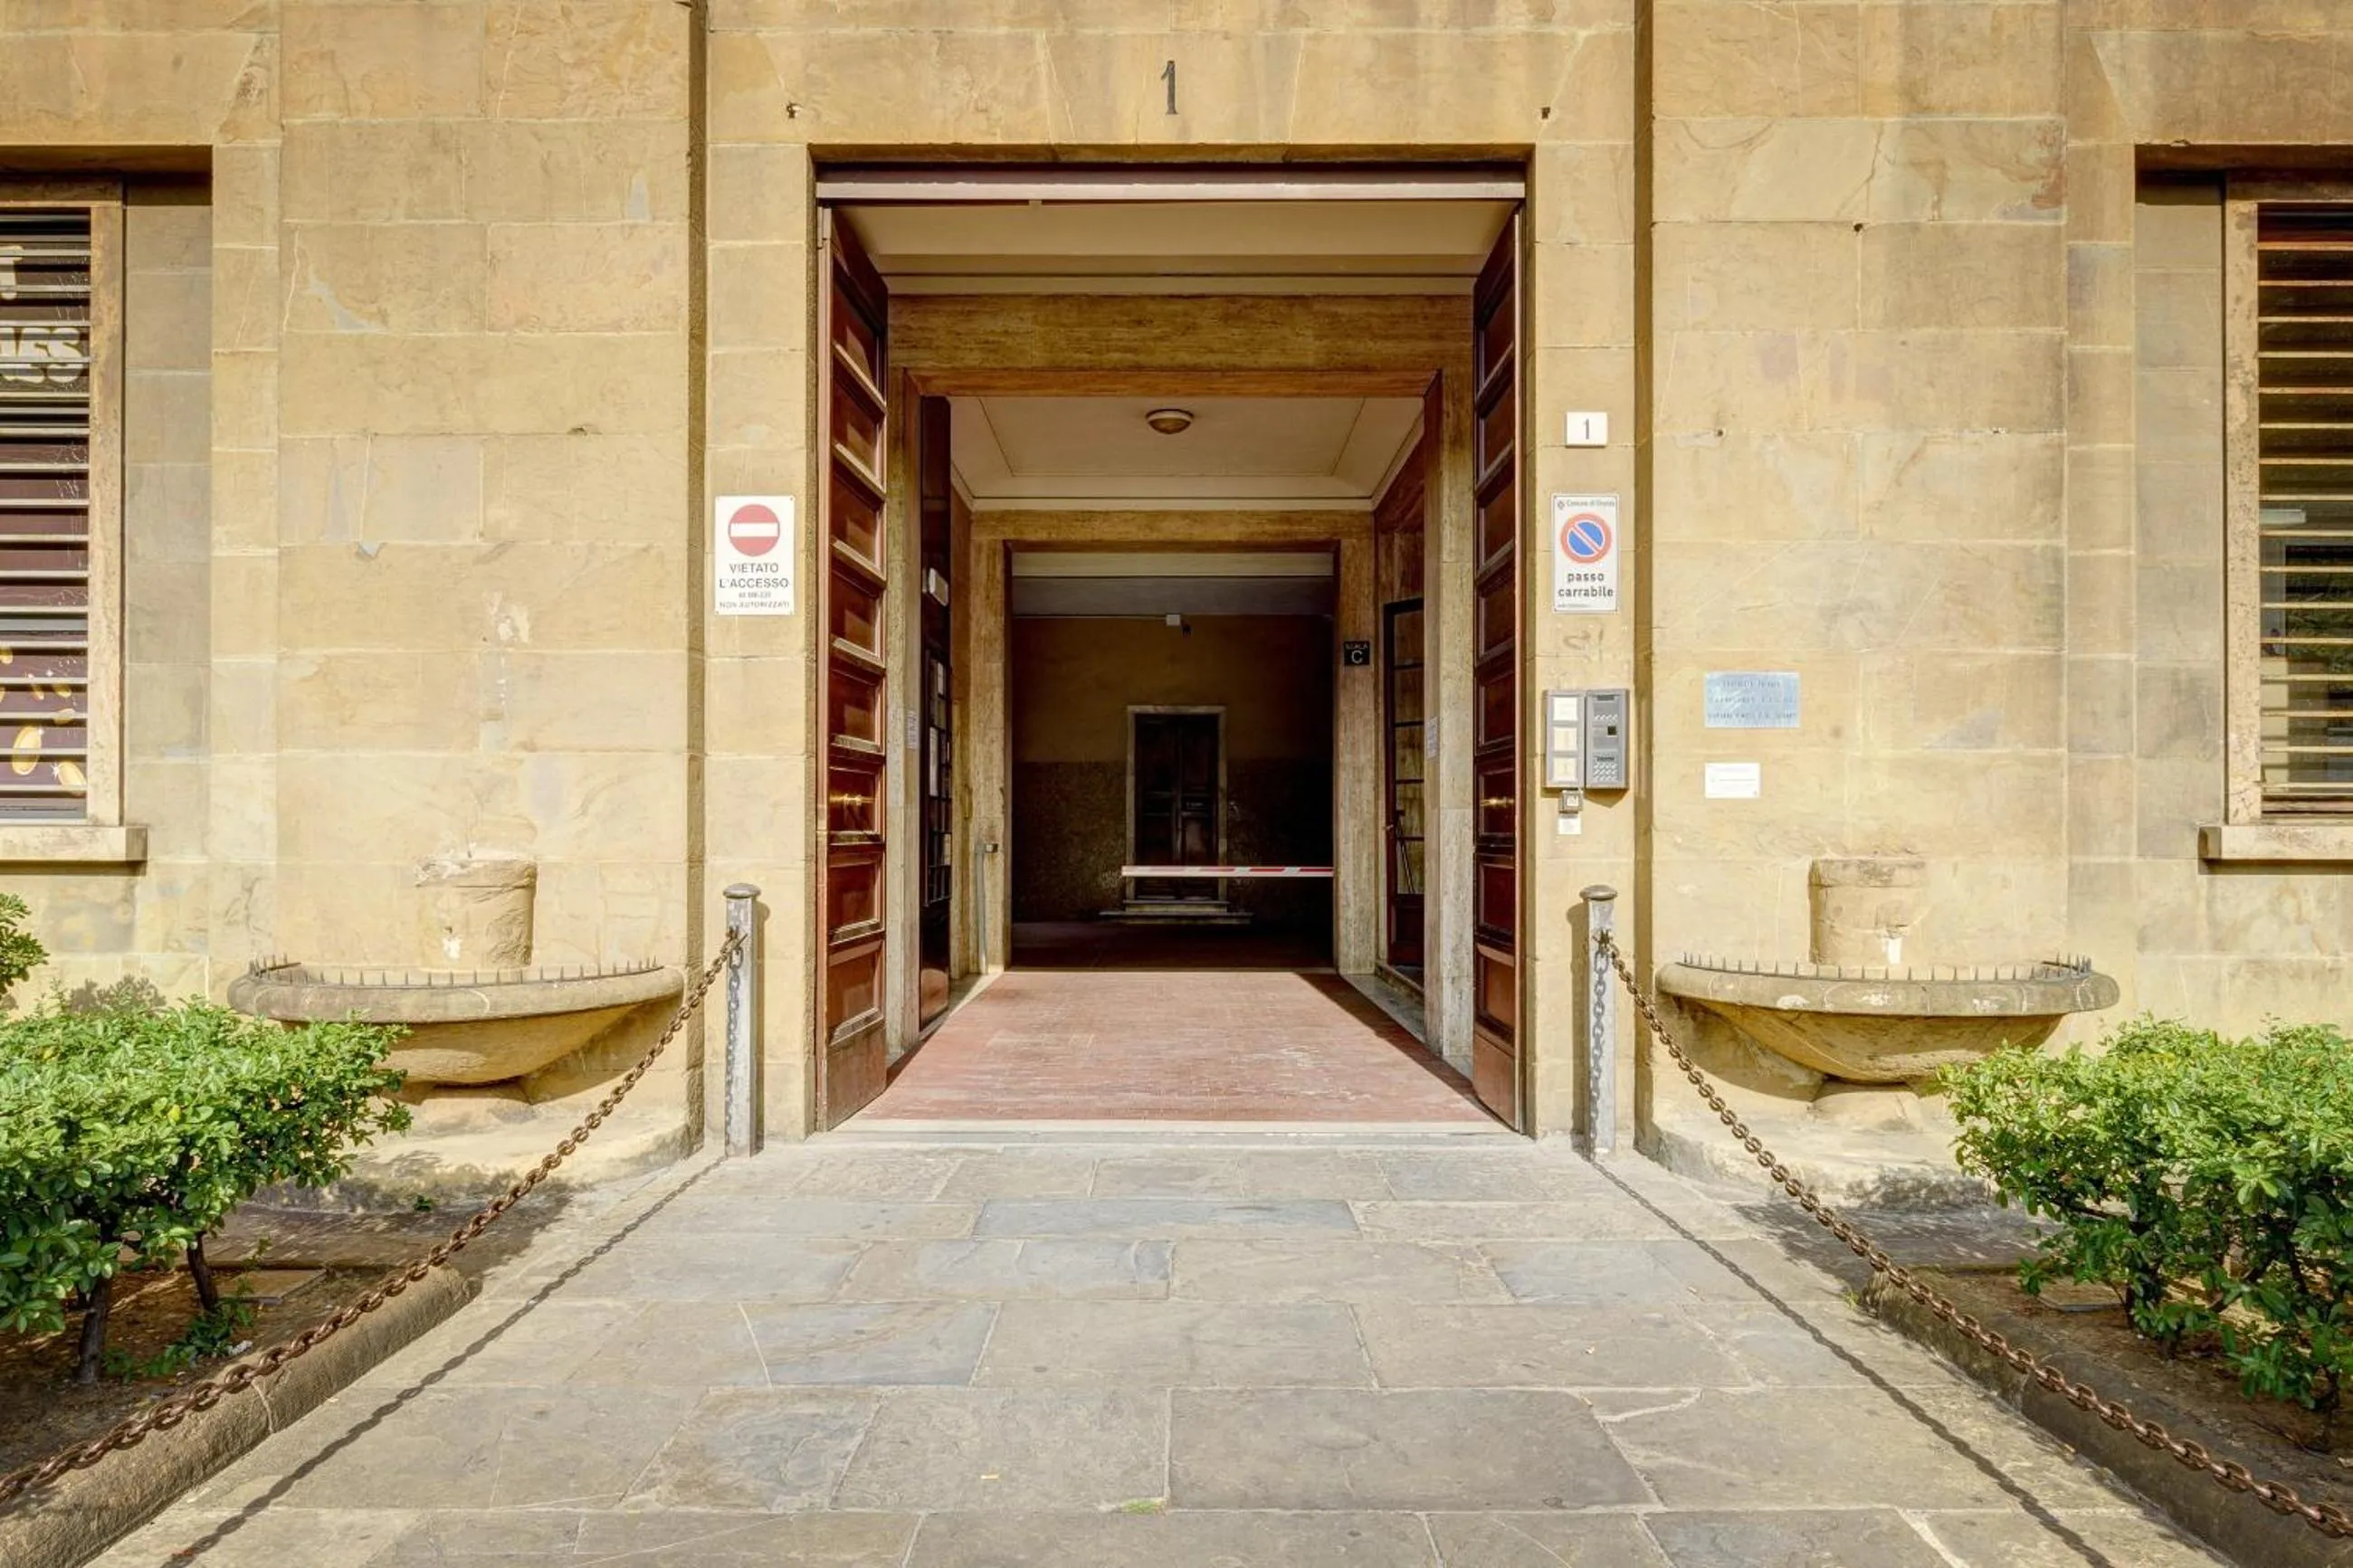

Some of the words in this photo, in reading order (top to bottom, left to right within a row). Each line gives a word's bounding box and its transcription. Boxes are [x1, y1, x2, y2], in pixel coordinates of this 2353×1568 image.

[1160, 60, 1178, 115] 1
[1583, 418, 1590, 440] 1
[729, 562, 779, 574] VIETATO
[719, 577, 789, 589] L'ACCESSO
[1567, 572, 1605, 584] passo
[1558, 585, 1614, 598] carrabile
[1351, 650, 1364, 664] C
